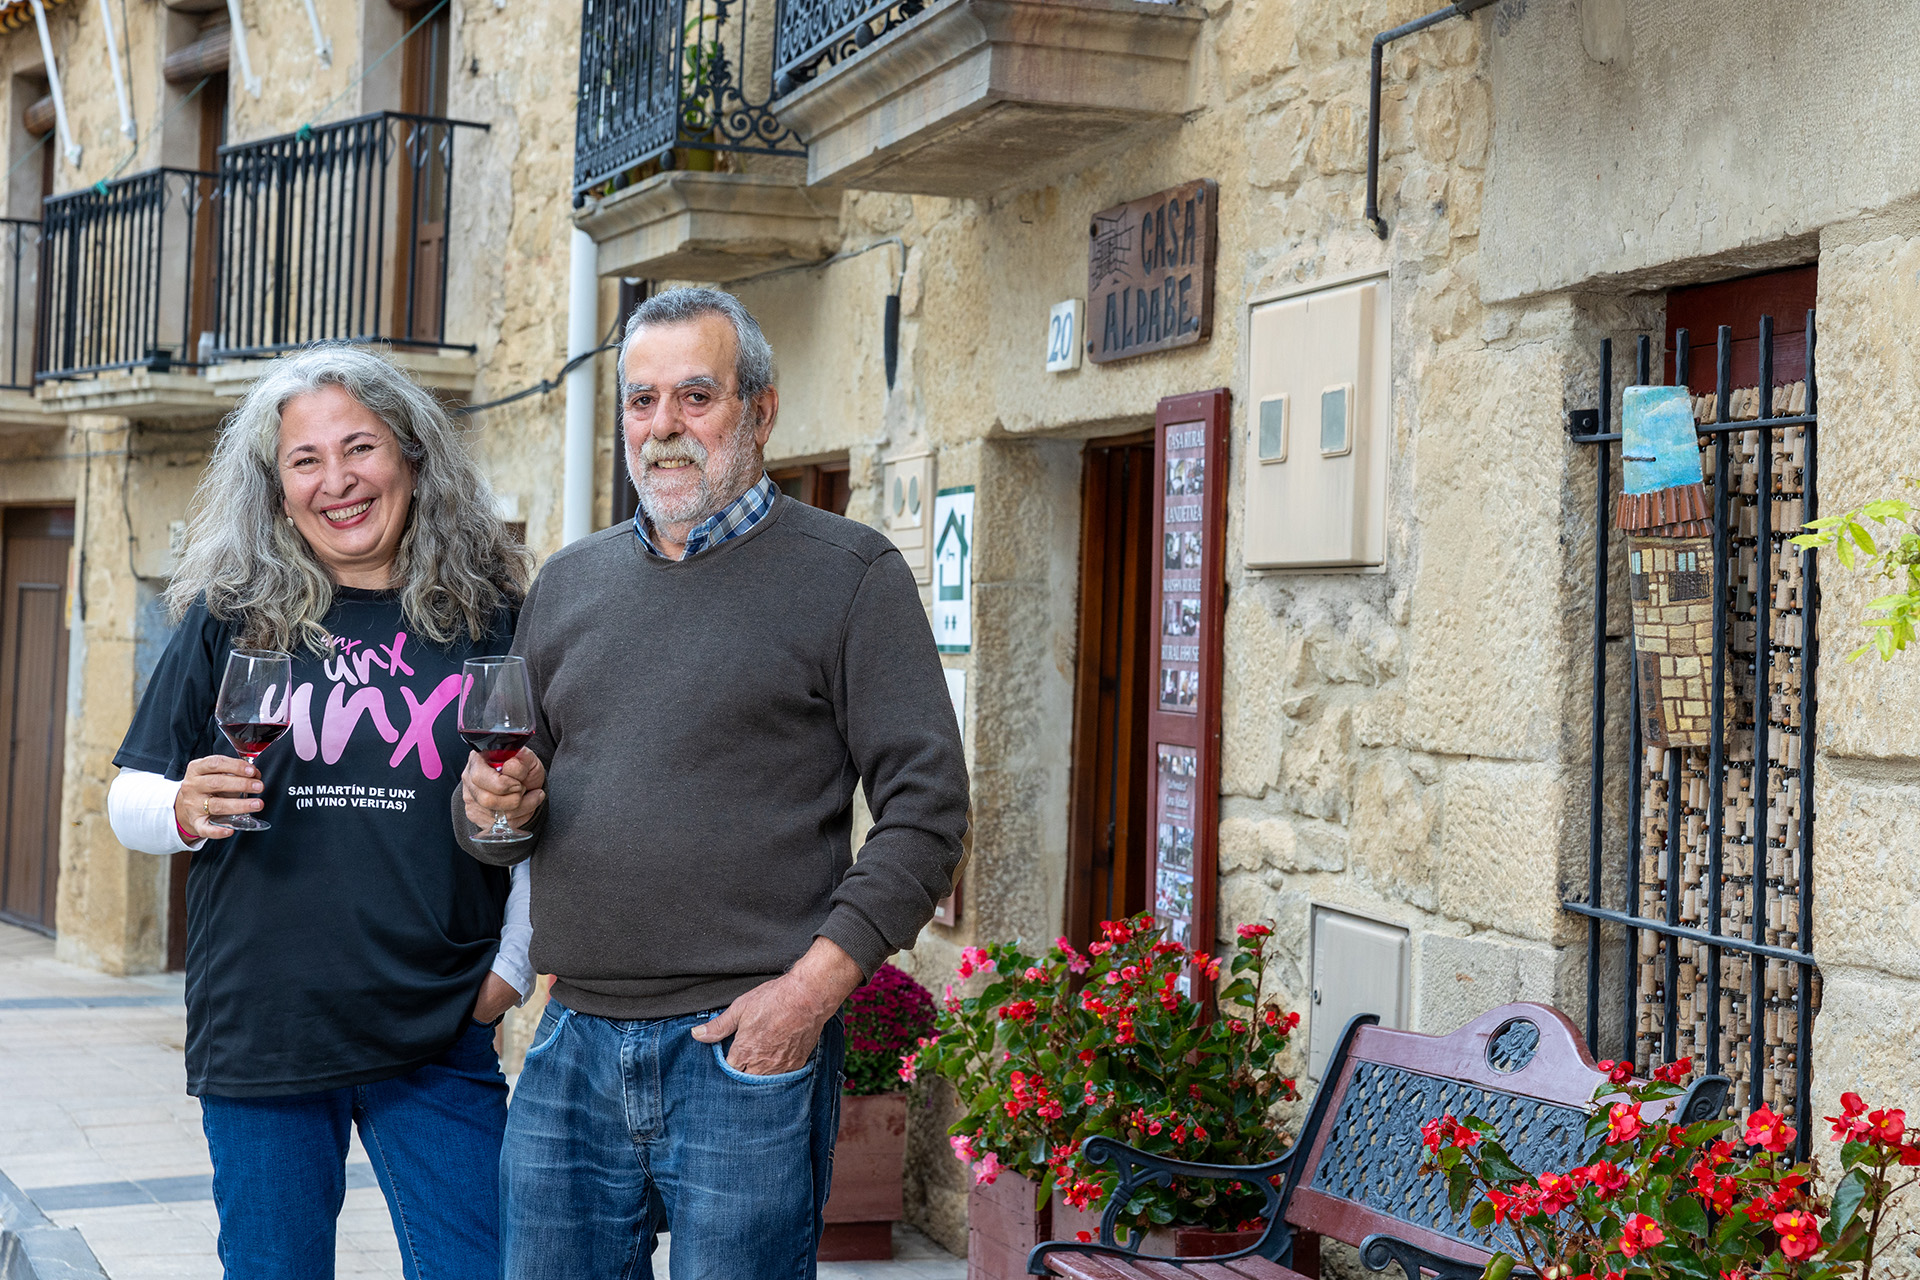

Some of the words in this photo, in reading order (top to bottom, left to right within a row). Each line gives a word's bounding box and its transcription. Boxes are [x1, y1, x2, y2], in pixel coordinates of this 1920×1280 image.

[1141, 198, 1197, 277] CASA
[1047, 312, 1073, 362] 20
[1103, 273, 1193, 353] ALDABE
[1166, 432, 1184, 451] CASA
[1184, 428, 1205, 447] RURAL
[323, 631, 415, 686] unx
[260, 673, 475, 780] unx
[288, 786, 313, 796] SAN
[316, 784, 365, 796] MARTÍN
[369, 787, 386, 797] DE
[388, 788, 416, 799] UNX
[296, 798, 313, 810] (IN
[316, 798, 347, 807] VINO
[350, 798, 407, 812] VERITAS)
